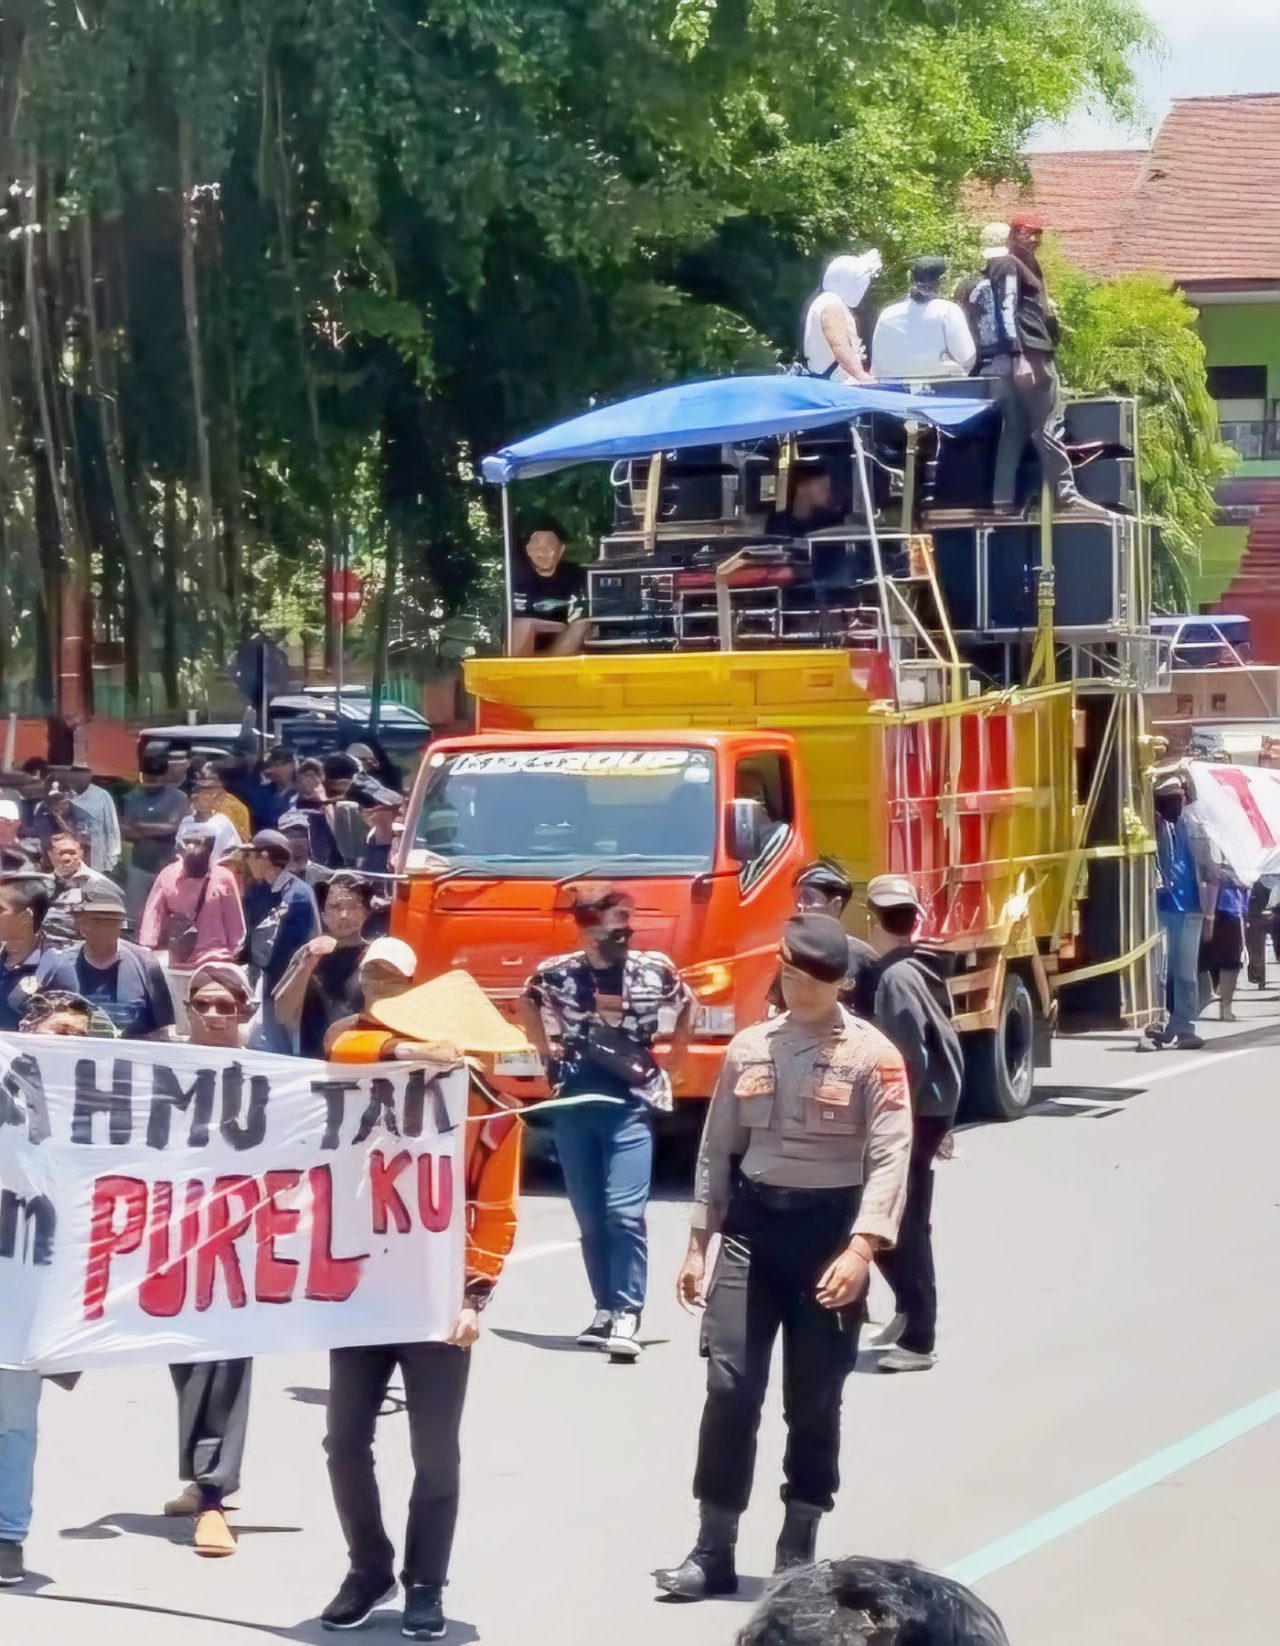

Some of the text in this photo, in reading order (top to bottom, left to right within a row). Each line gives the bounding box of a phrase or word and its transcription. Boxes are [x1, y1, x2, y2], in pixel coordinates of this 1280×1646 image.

[310, 1068, 459, 1150] TAK
[83, 1163, 370, 1320] PUREL
[370, 1149, 452, 1234] KU
